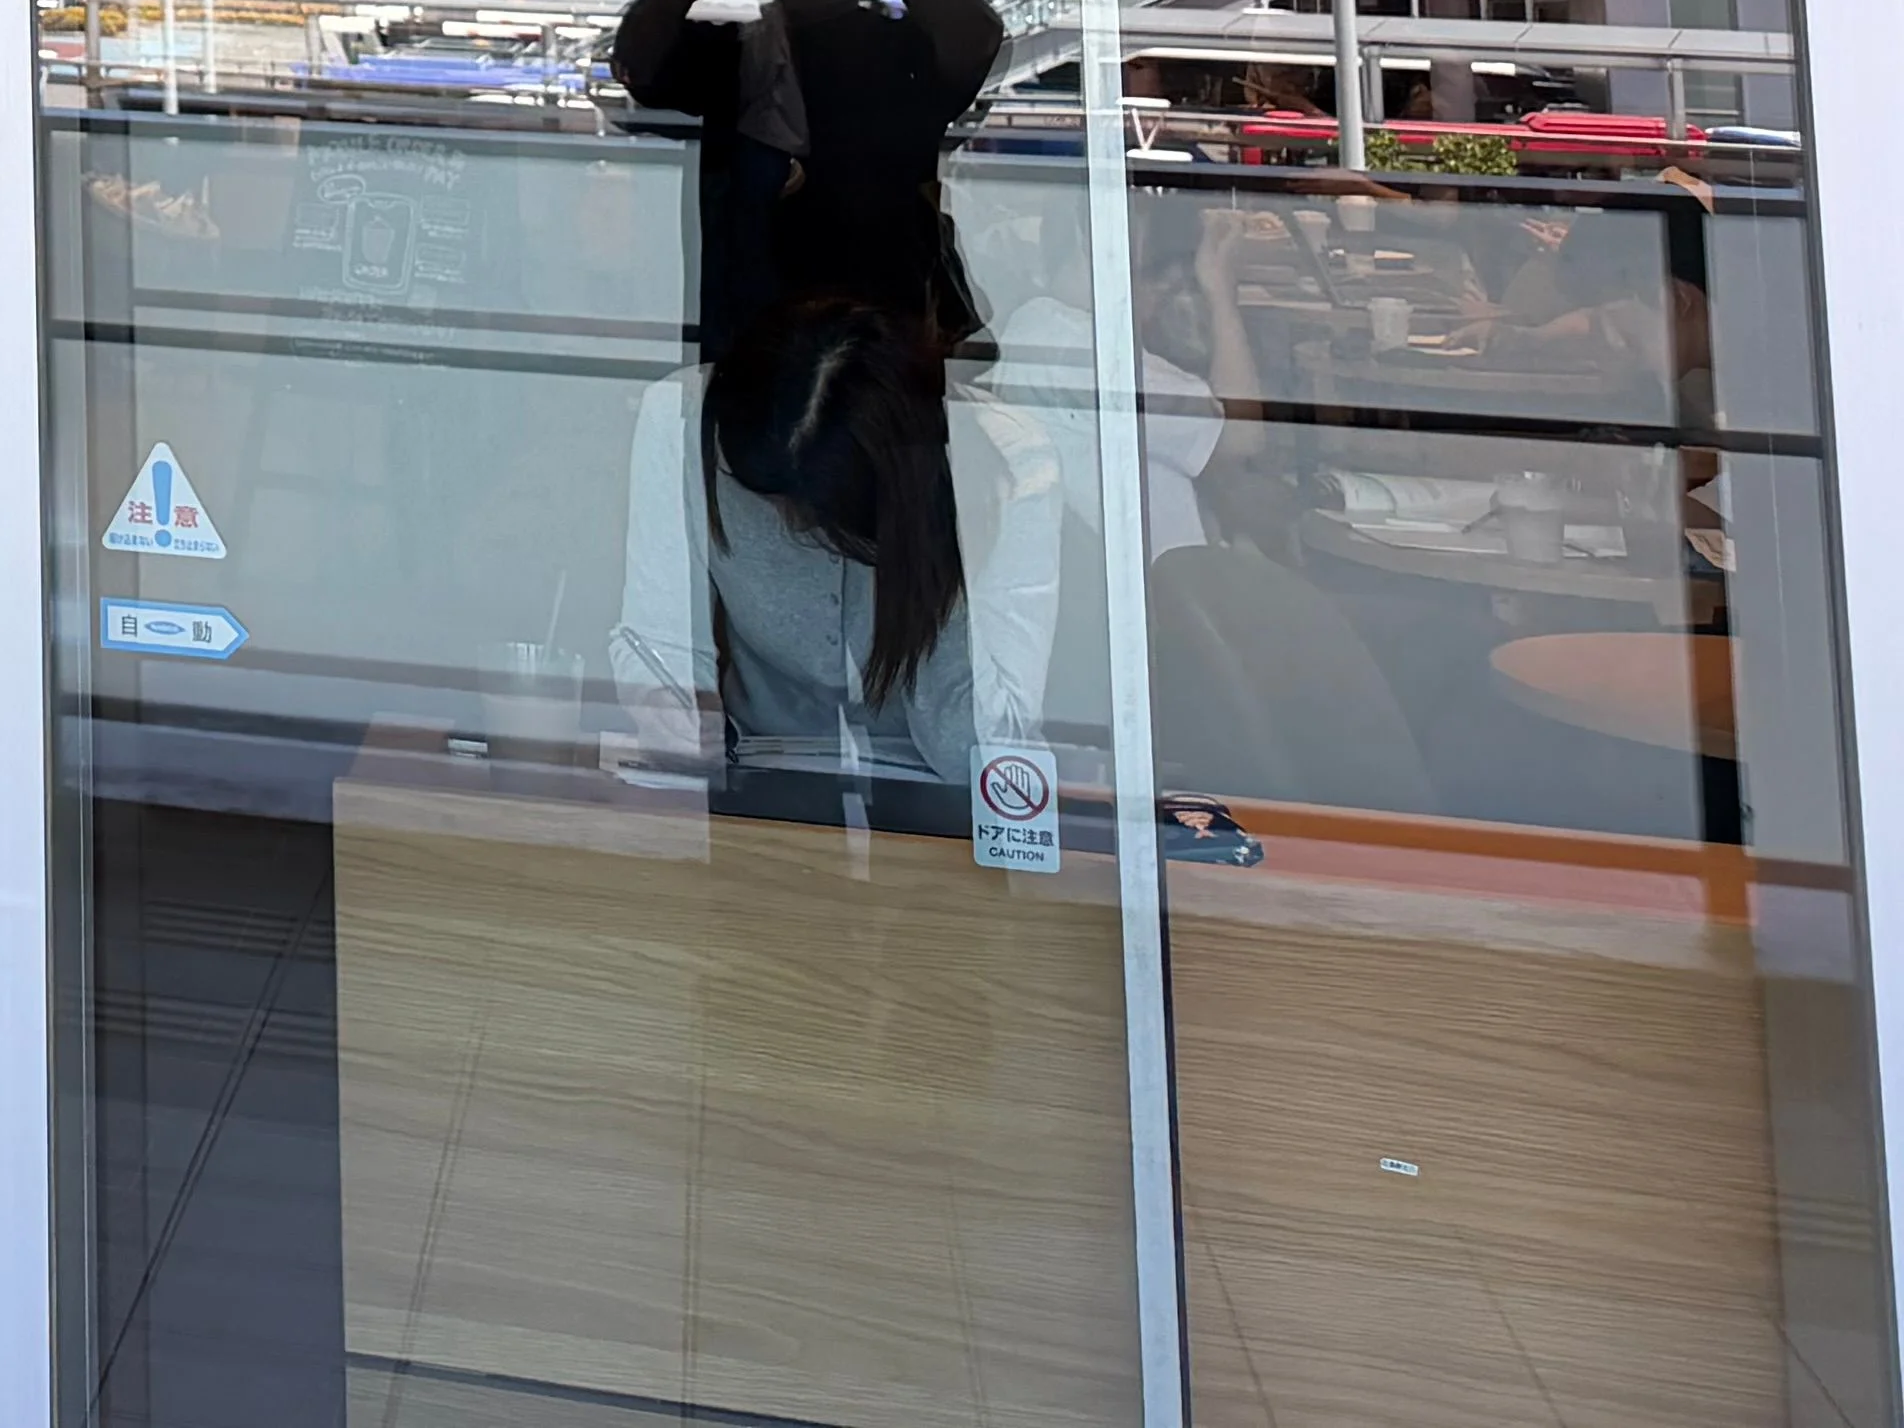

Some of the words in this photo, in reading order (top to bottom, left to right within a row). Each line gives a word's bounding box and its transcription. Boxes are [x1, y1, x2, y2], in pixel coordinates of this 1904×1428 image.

[977, 824, 1054, 847] ドアに注意
[989, 846, 1044, 862] CAUTION
